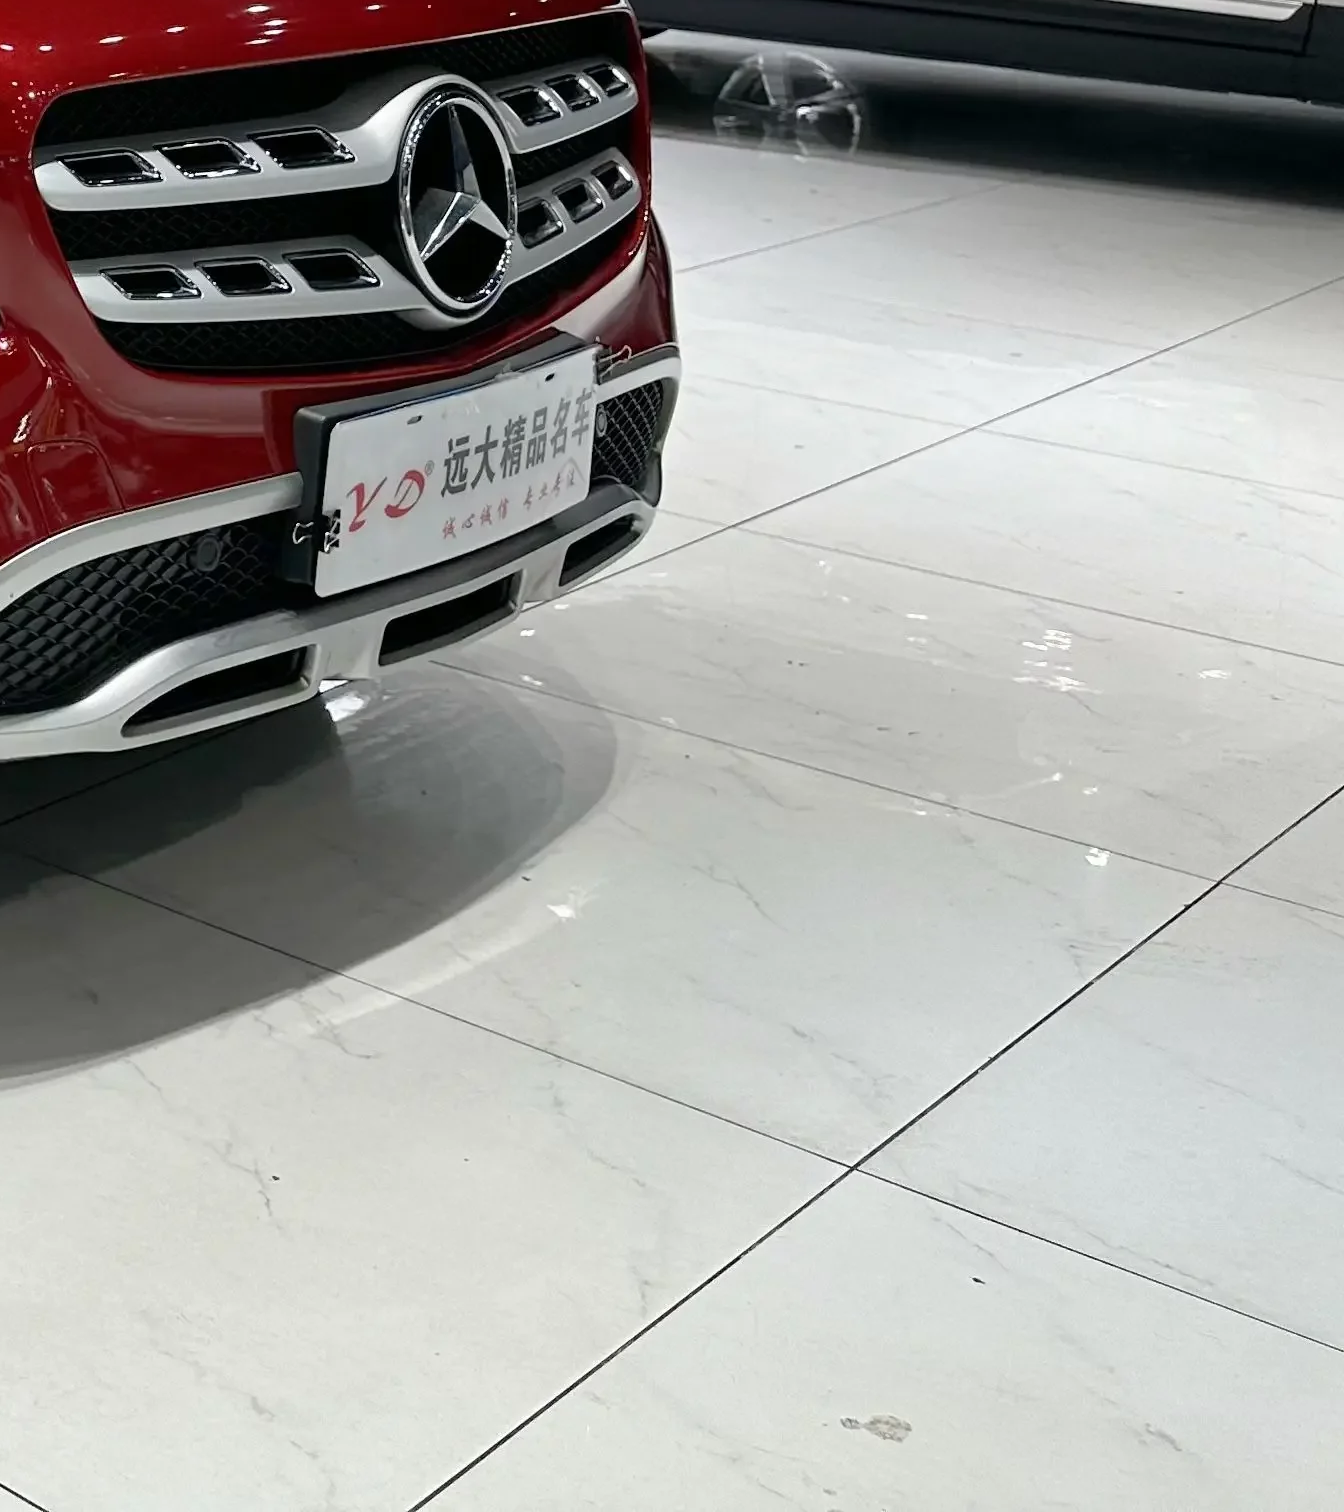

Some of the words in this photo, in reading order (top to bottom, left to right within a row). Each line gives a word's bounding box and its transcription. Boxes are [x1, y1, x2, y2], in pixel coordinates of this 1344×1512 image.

[441, 388, 593, 498] 远大精品名车
